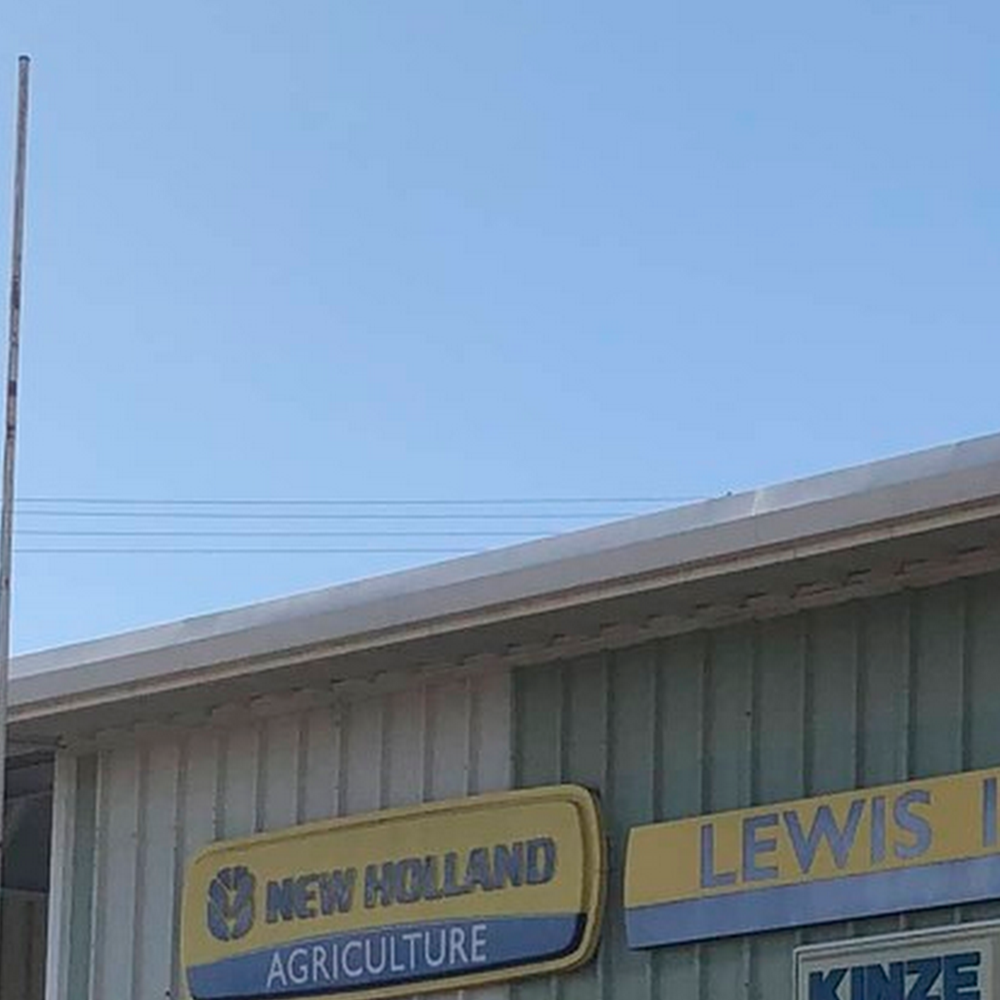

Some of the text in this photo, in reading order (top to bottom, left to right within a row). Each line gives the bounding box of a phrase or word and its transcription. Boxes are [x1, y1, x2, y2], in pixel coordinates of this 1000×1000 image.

[266, 836, 557, 924] NEW HOLLAND
[701, 789, 933, 889] LEWIS
[266, 923, 488, 989] AGRICULTURE
